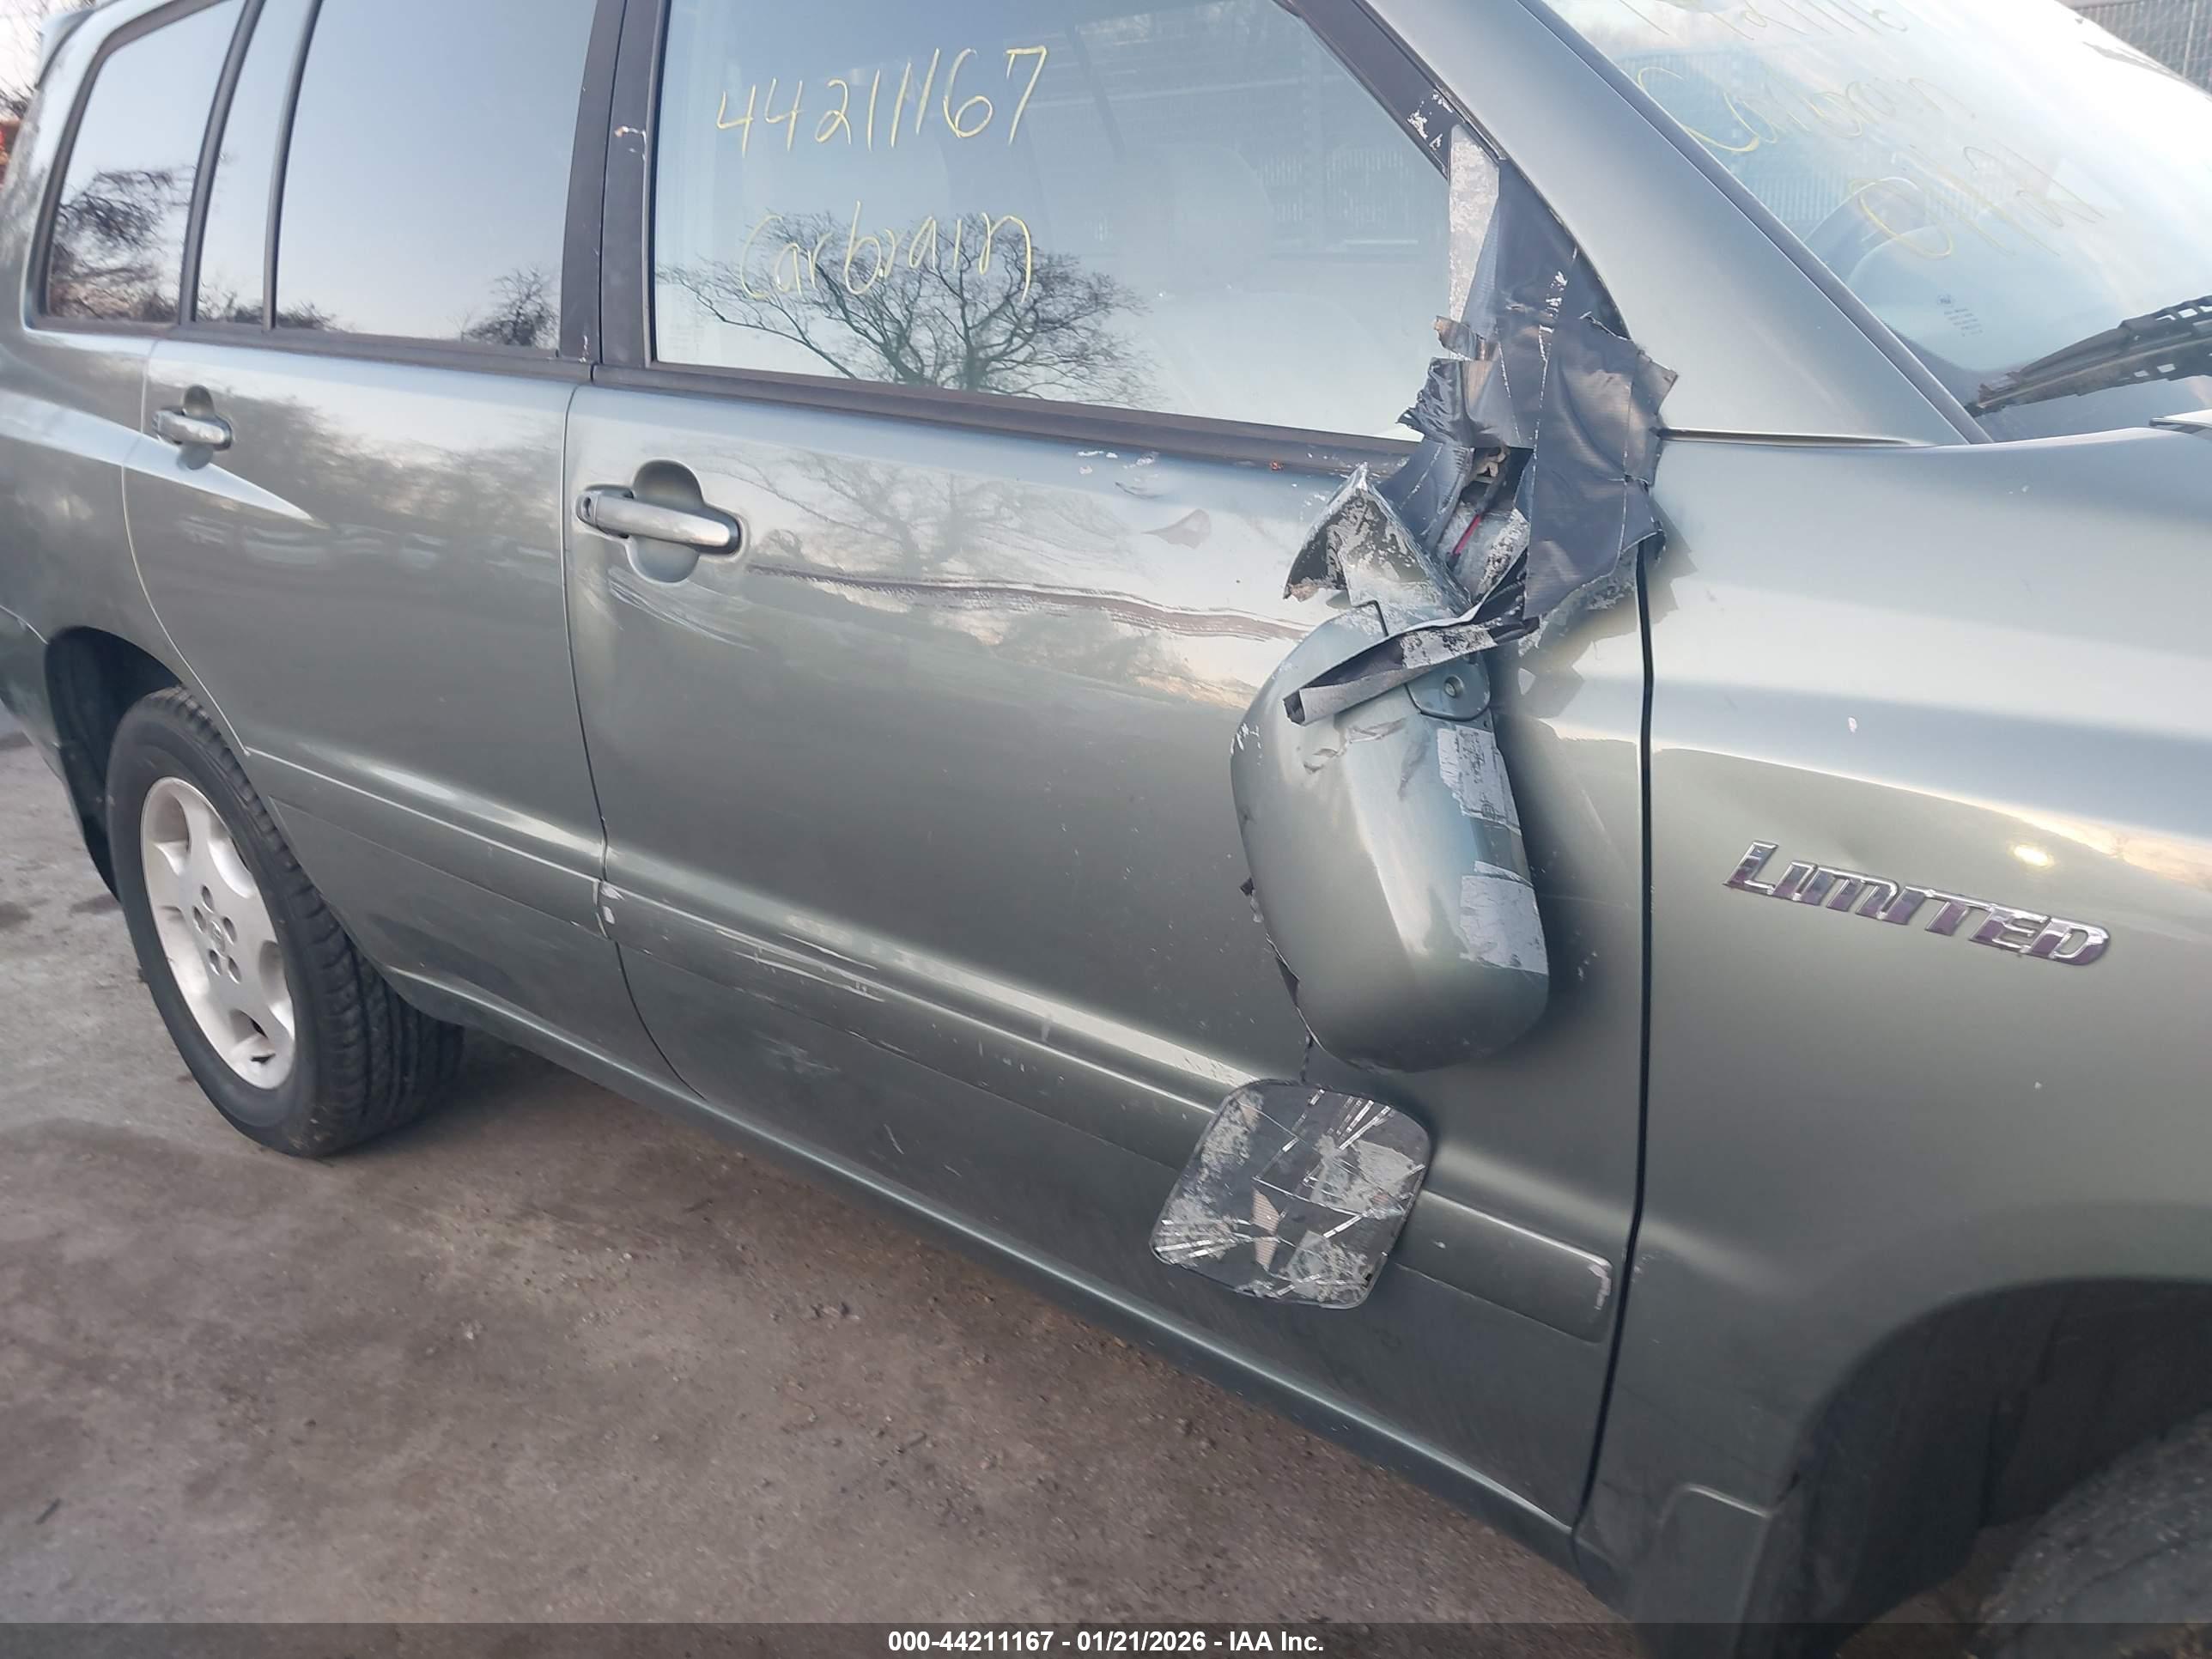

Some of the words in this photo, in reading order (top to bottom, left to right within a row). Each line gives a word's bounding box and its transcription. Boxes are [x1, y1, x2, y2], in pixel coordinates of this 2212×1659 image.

[715, 46, 1048, 158] 44211167
[740, 200, 1032, 302] Carbrain
[1721, 839, 2112, 967] LIMITED
